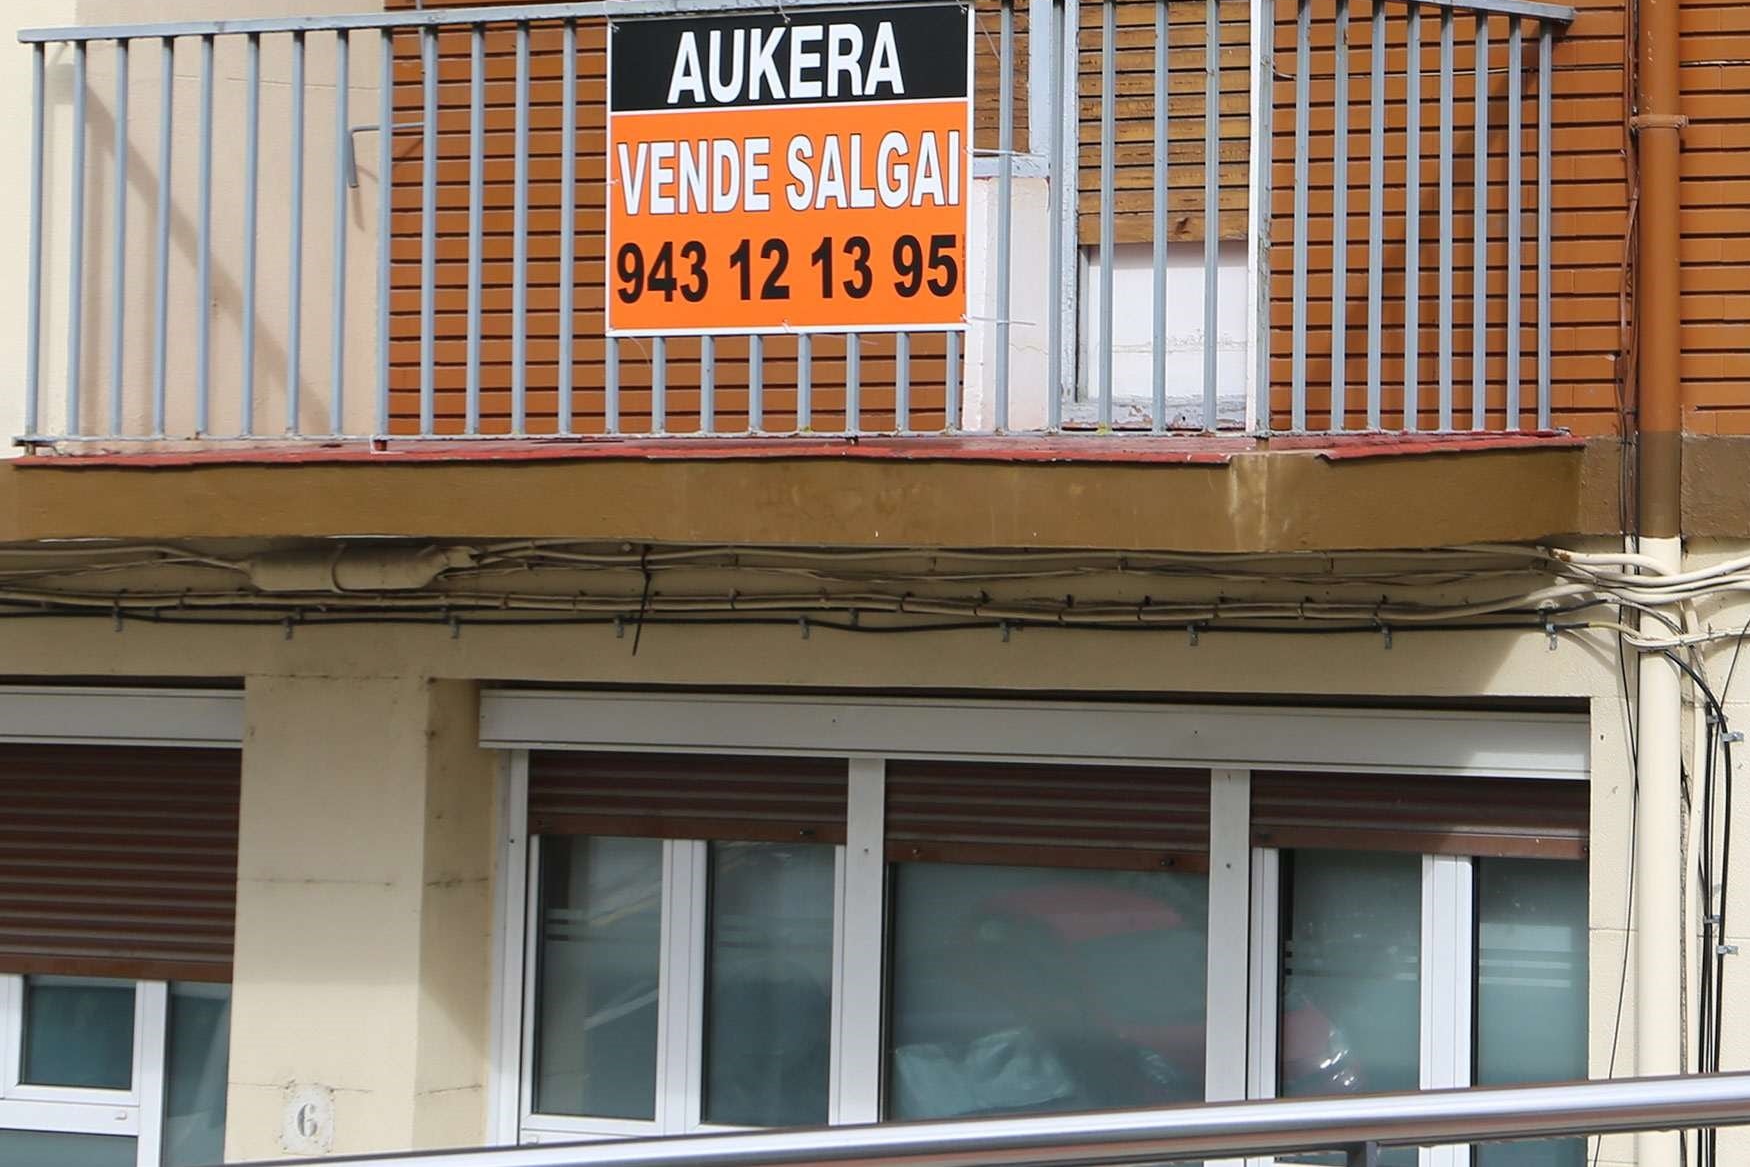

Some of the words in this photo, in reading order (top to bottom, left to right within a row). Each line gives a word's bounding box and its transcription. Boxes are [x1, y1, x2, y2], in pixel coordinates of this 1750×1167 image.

[667, 21, 905, 104] AUKERA
[617, 136, 772, 216] VENDE
[785, 130, 961, 211] SALGAI
[616, 241, 709, 304] 943
[729, 238, 790, 301] 12
[811, 236, 873, 299] 13
[892, 234, 958, 298] 95
[297, 1103, 318, 1138] 6
